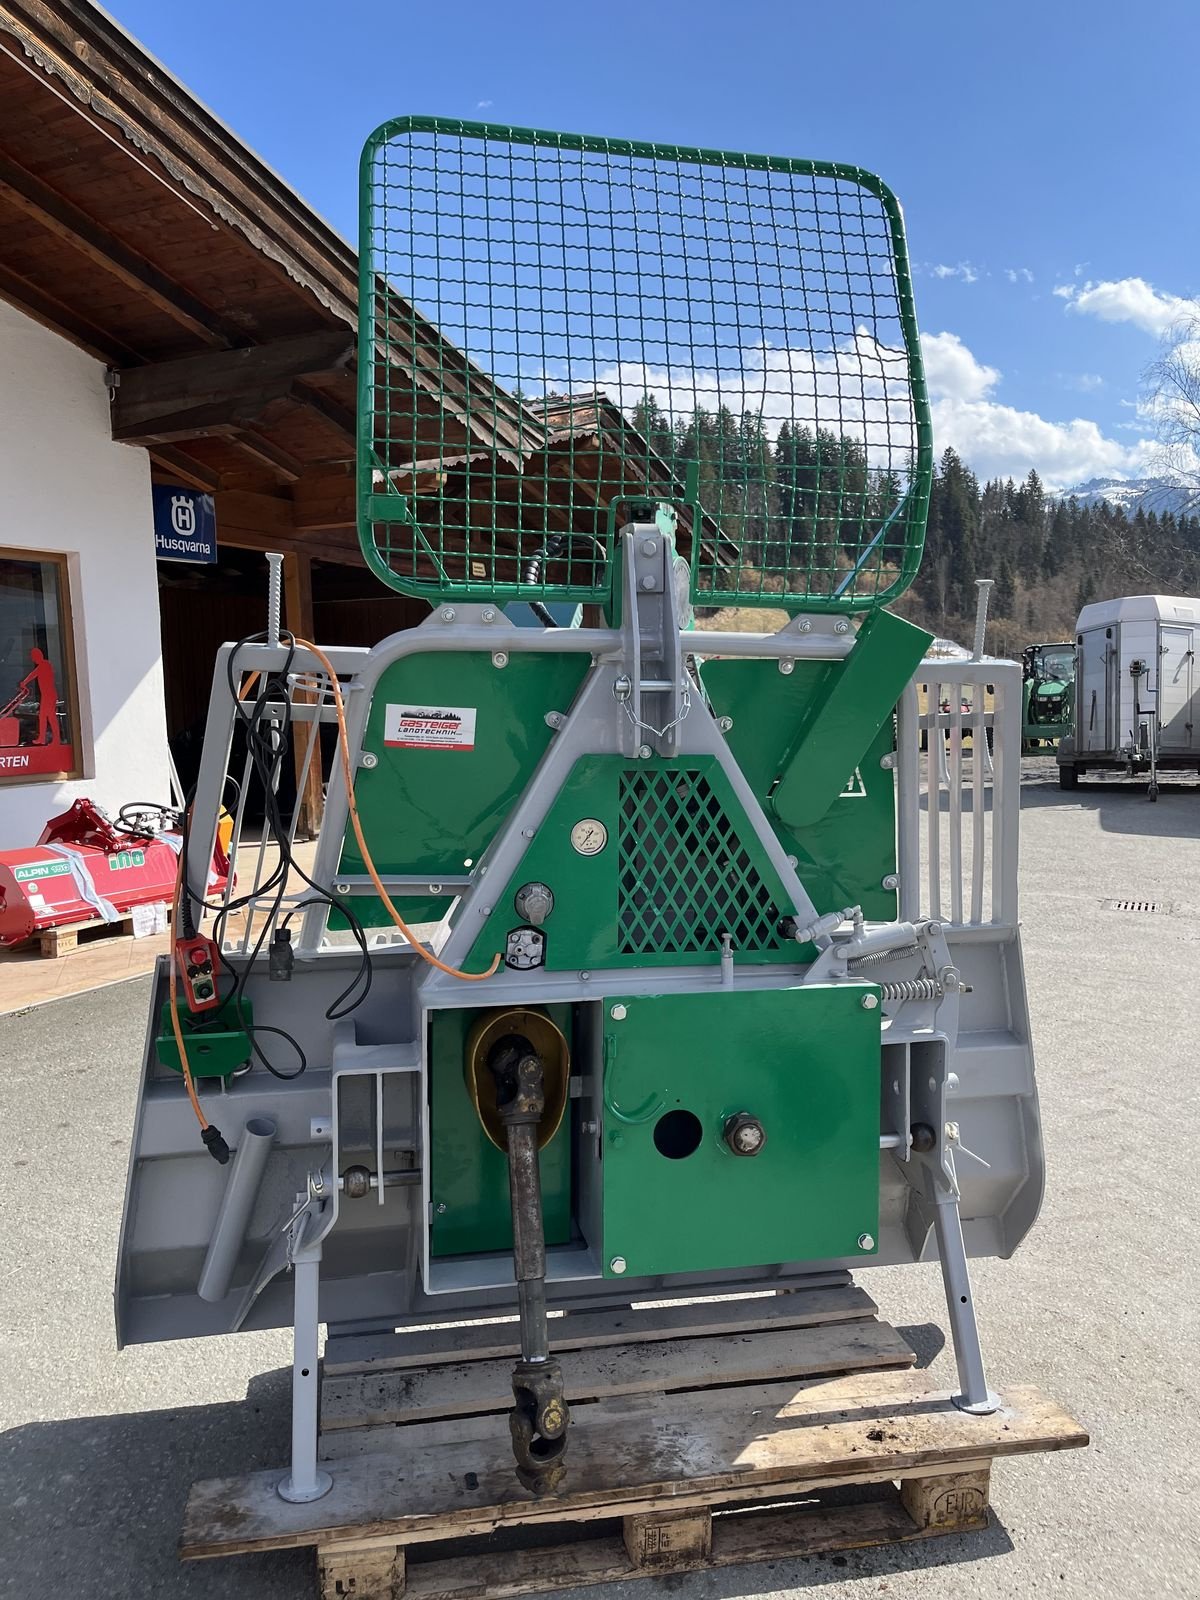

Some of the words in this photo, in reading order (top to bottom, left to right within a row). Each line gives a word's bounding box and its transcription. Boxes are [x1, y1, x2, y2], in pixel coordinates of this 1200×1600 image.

[177, 507, 190, 529] H
[155, 534, 211, 554] Husqvarna
[17, 867, 49, 879] ALPIN
